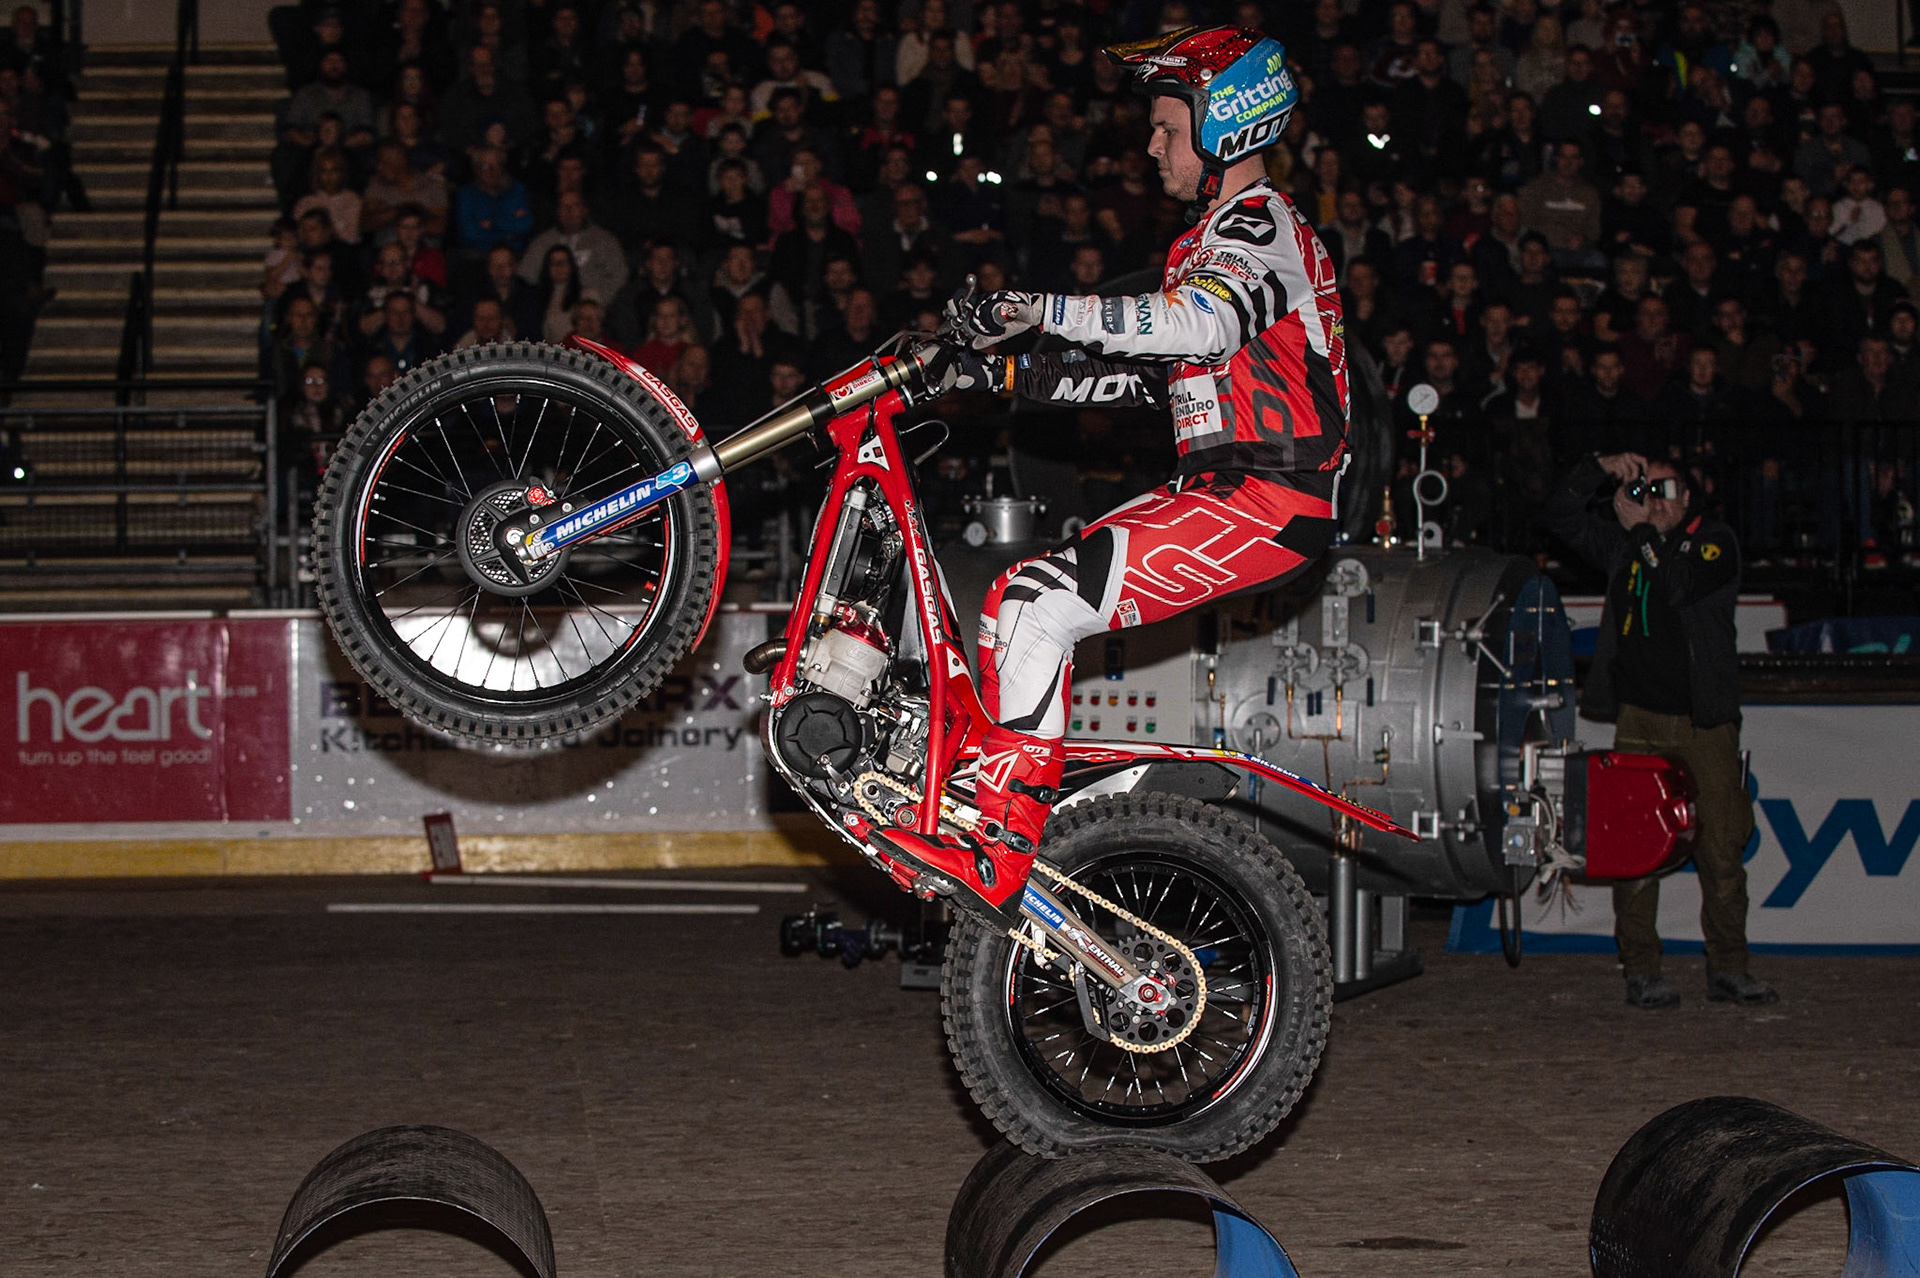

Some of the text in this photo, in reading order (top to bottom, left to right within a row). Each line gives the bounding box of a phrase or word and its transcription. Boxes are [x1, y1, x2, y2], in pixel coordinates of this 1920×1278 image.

[1211, 84, 1237, 101] THE
[1213, 69, 1293, 122] Gritting
[1236, 91, 1288, 124] COMPANY
[1218, 107, 1294, 160] MOT
[1220, 250, 1250, 266] TRIAL
[379, 380, 442, 432] MICHELIN
[641, 370, 699, 430] GASGAS
[852, 375, 876, 390] DIRECT
[556, 484, 652, 541] MICHELIN
[917, 547, 943, 645] GASGAS
[17, 670, 211, 743] heart
[58, 751, 83, 767] up
[86, 748, 117, 765] the
[121, 748, 155, 765] feel
[600, 721, 743, 752] Joinery
